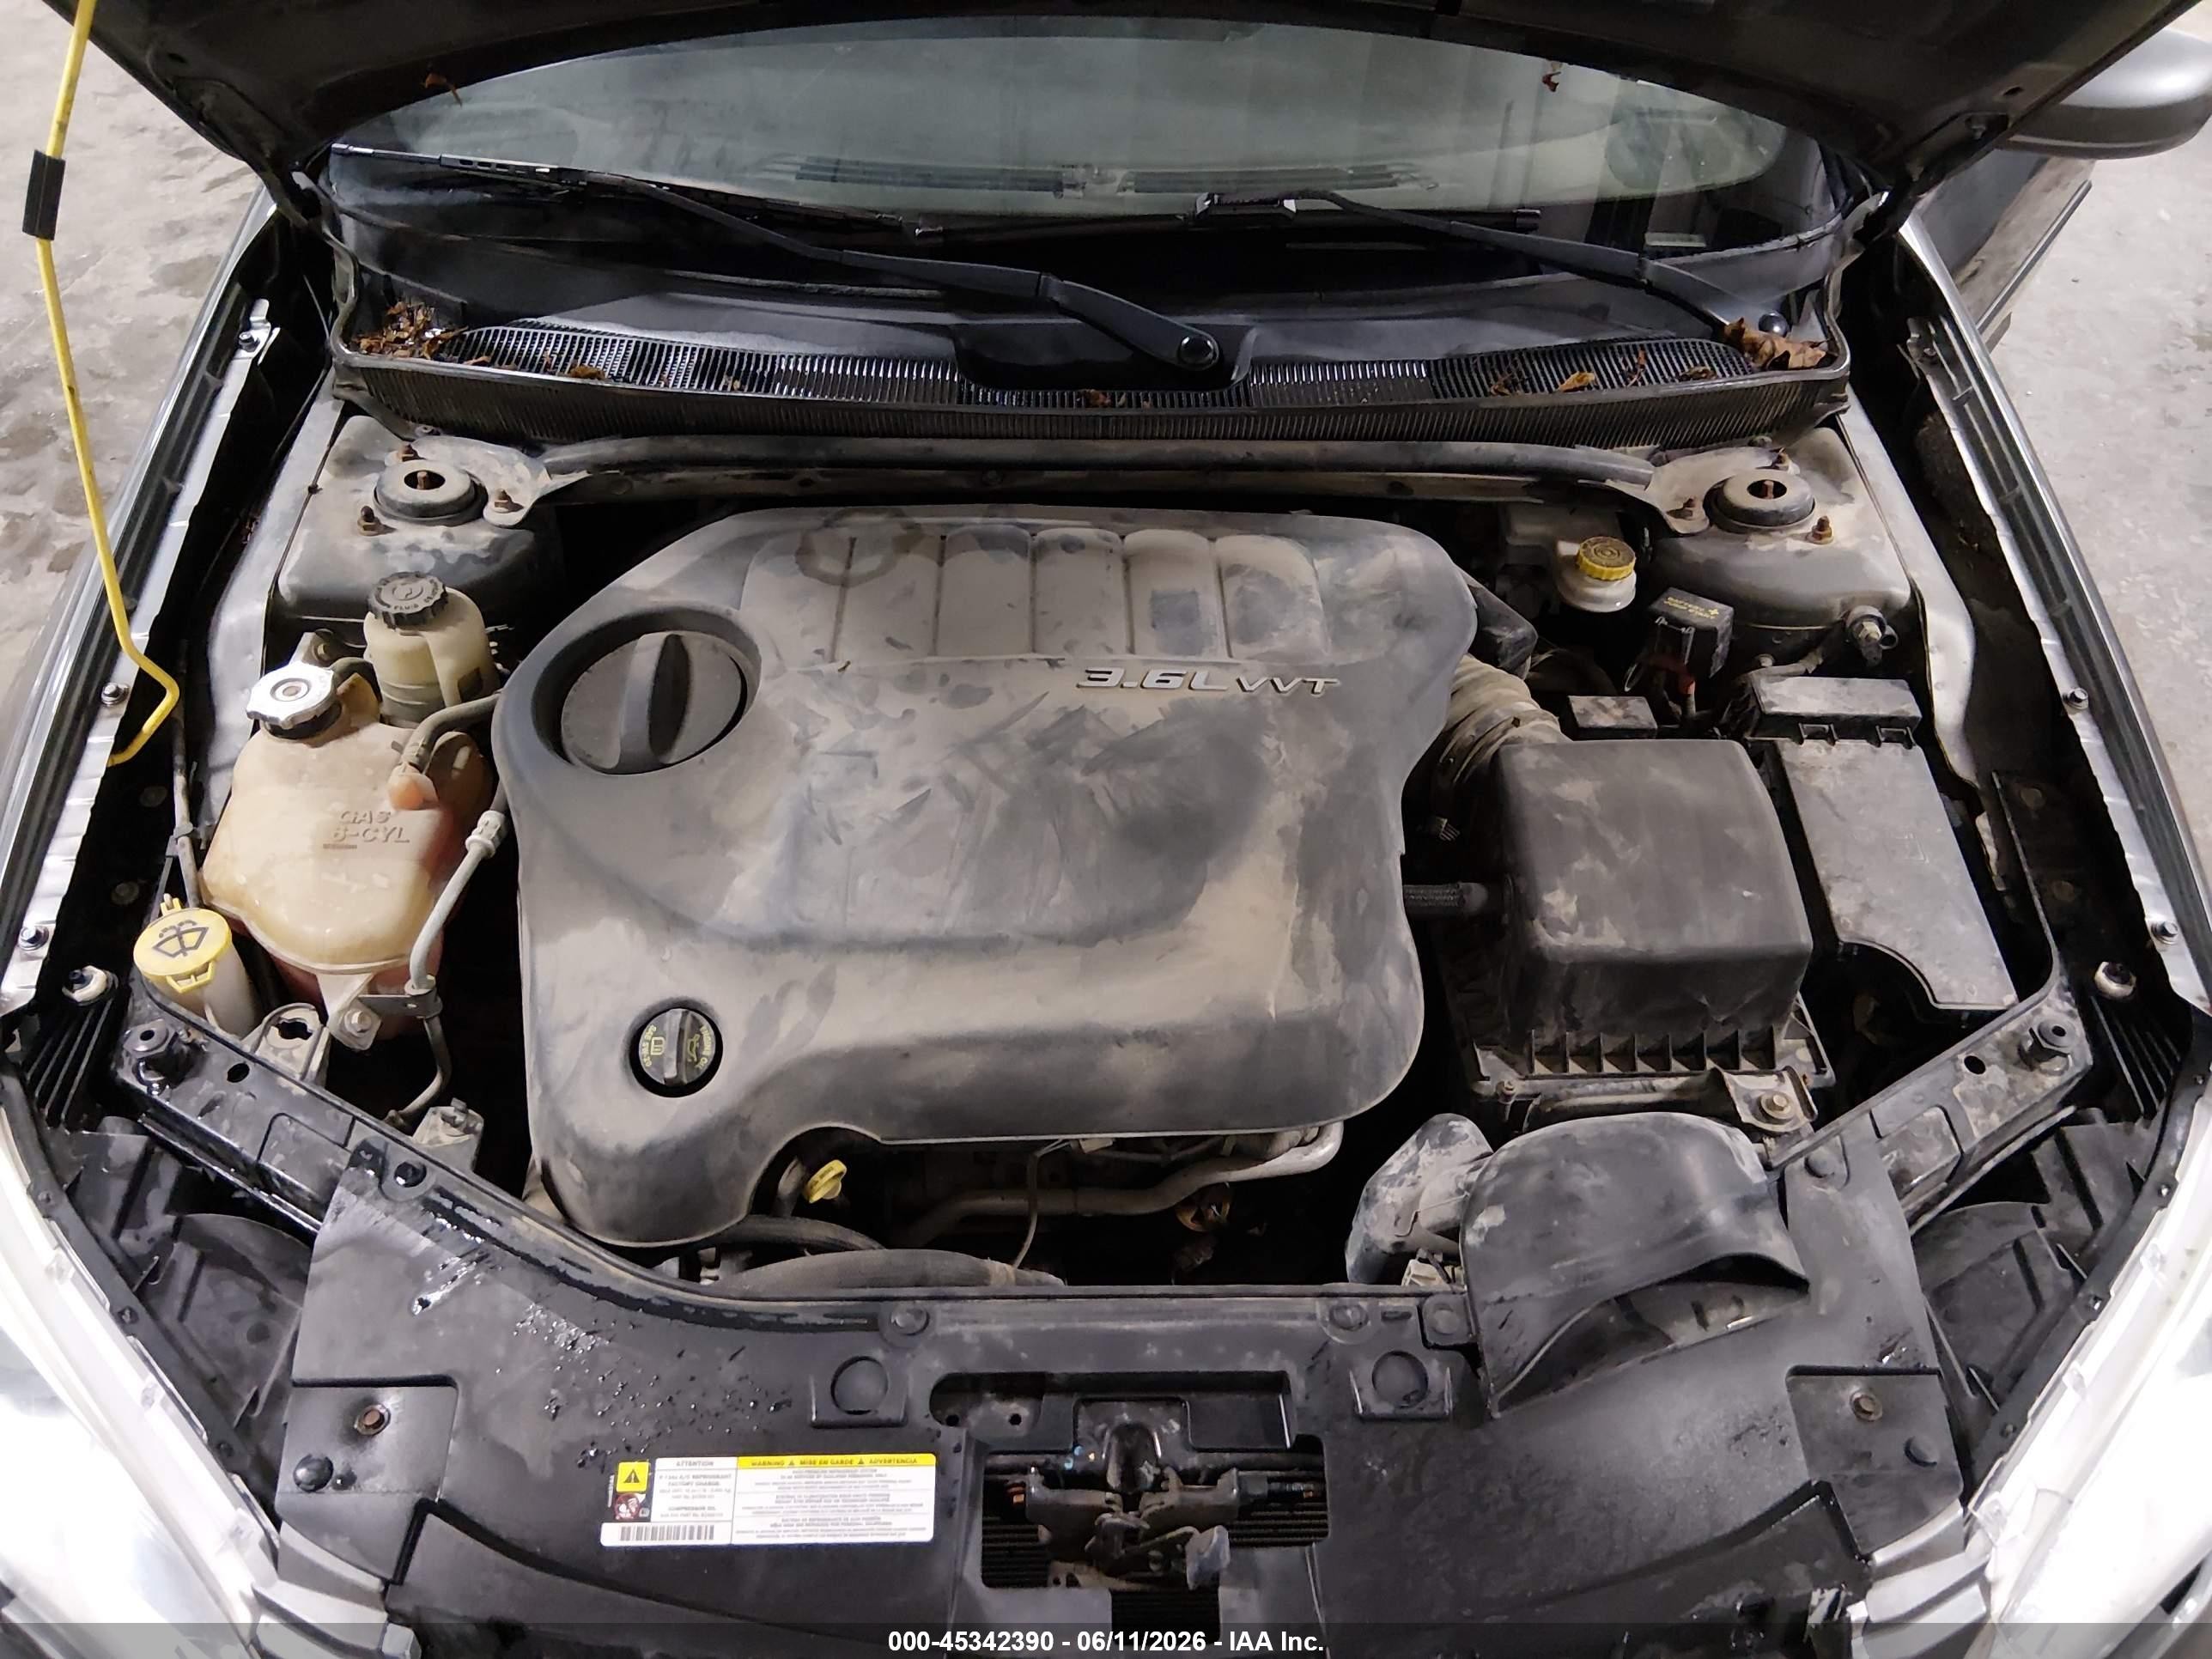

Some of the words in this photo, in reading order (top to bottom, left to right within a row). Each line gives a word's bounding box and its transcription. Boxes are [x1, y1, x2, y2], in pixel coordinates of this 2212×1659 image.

[1076, 667, 1228, 690] 3.6L
[1237, 675, 1342, 695] VVT
[339, 811, 392, 825] GAS
[332, 827, 410, 843] 6-CYL
[700, 1025, 712, 1056] ENGINE
